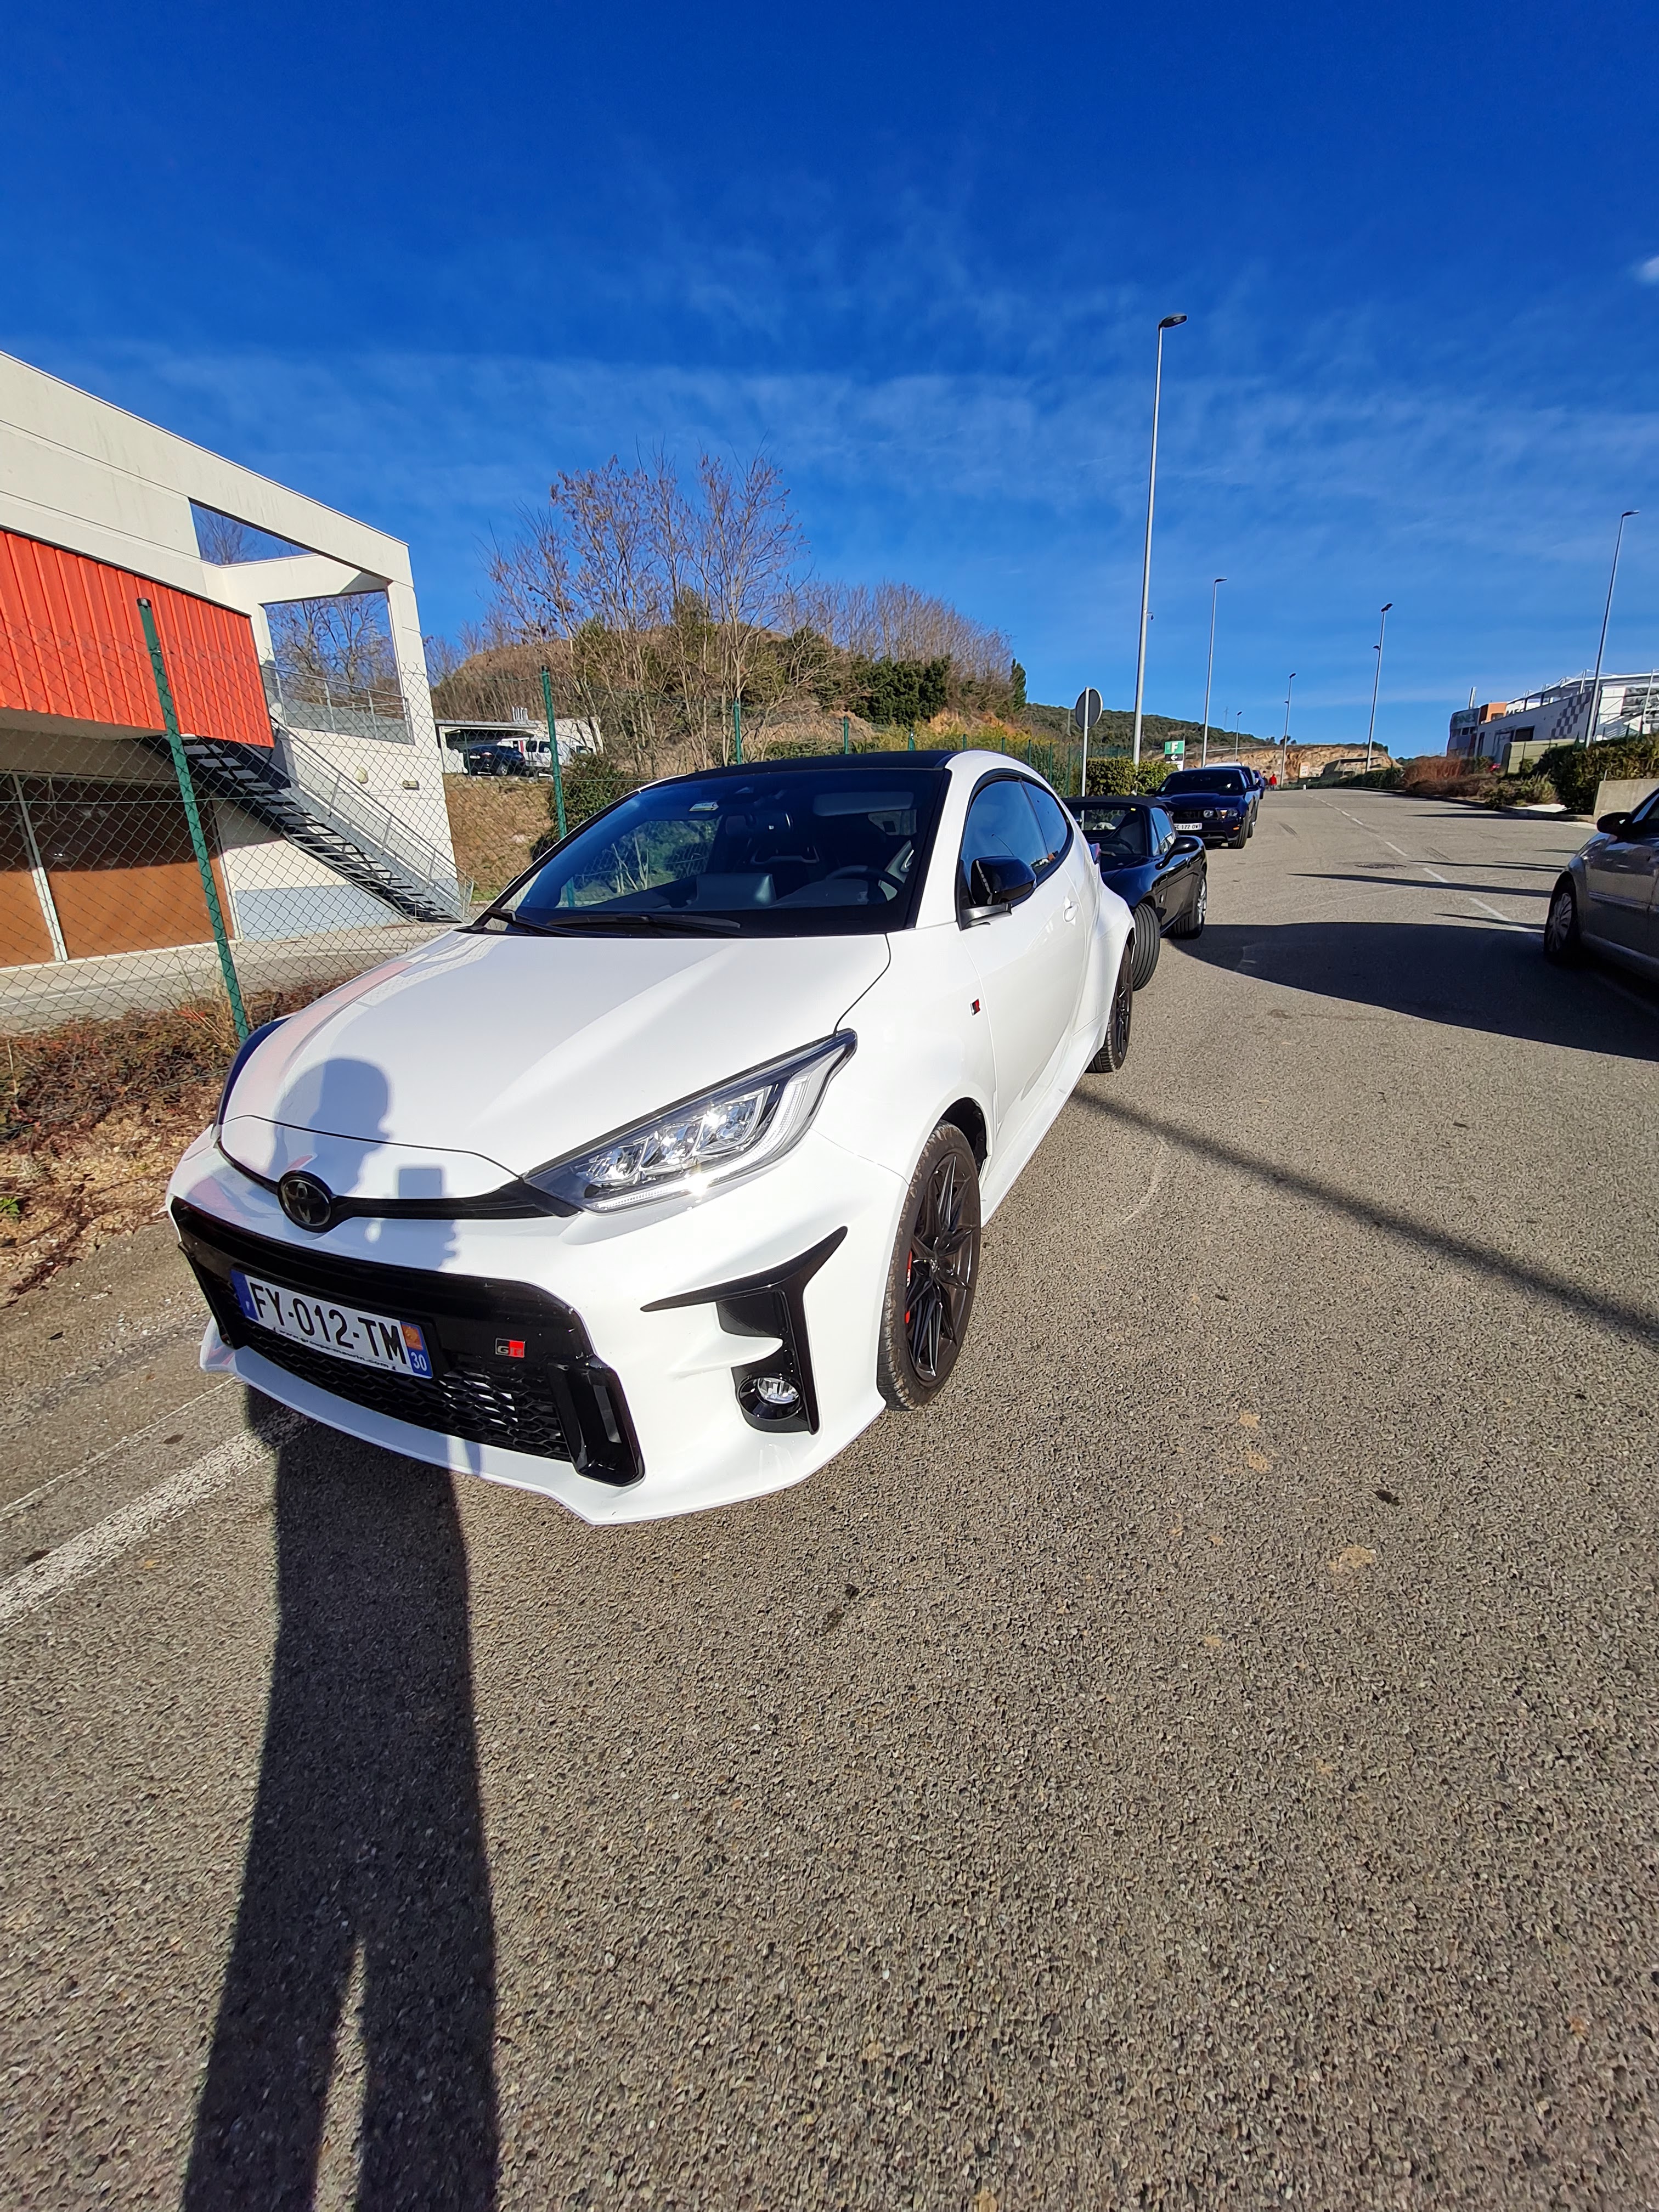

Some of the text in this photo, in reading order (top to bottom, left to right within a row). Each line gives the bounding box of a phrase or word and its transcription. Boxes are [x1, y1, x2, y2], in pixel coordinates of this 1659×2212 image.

[1171, 742, 1178, 753] F
[250, 1282, 407, 1364] FY-012-TM
[497, 1346, 523, 1357] GR
[410, 1352, 427, 1372] 30
